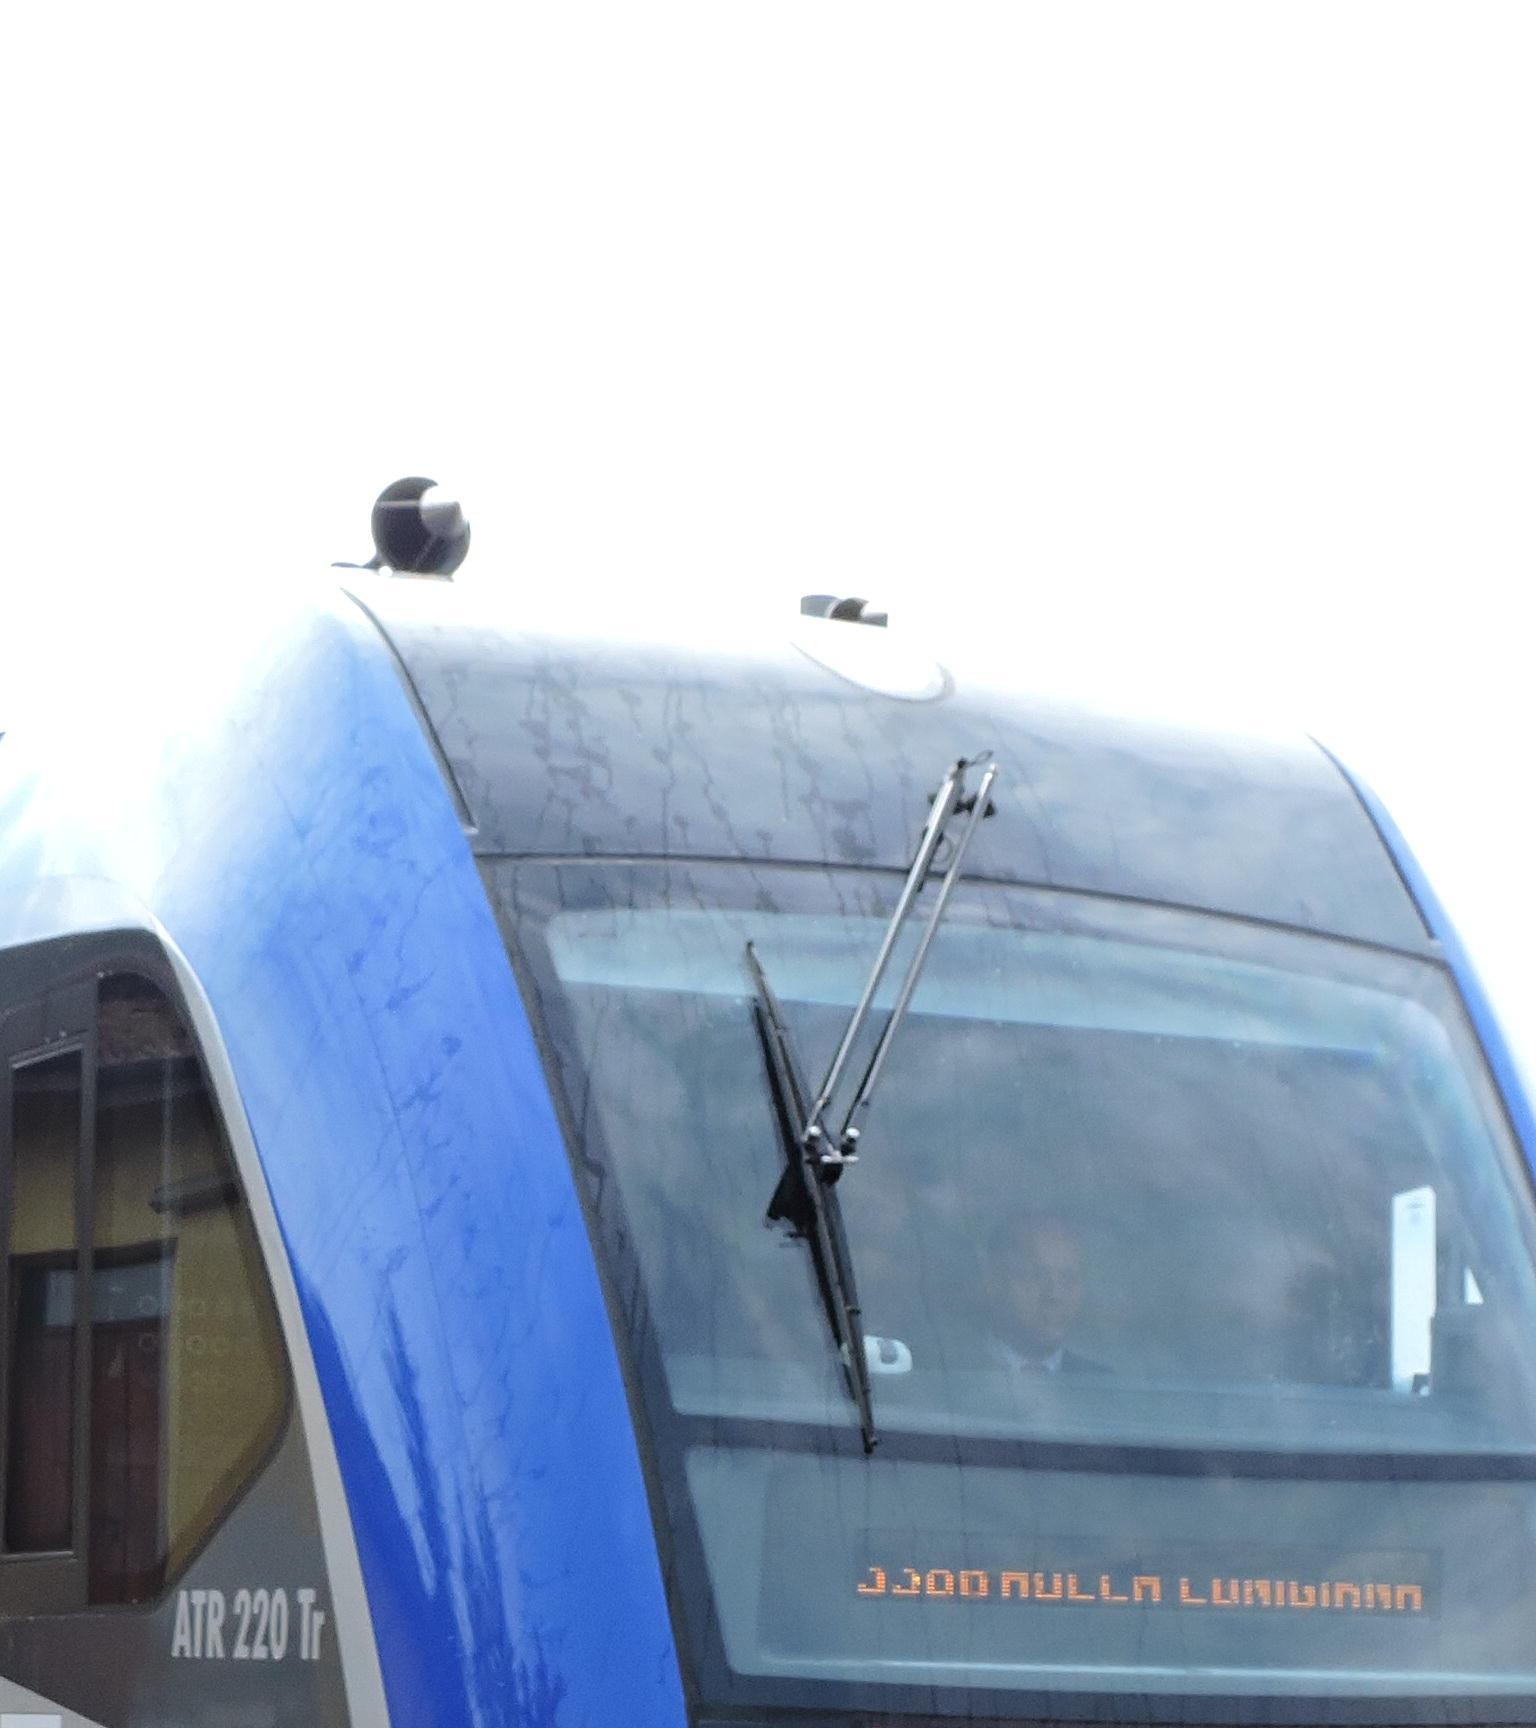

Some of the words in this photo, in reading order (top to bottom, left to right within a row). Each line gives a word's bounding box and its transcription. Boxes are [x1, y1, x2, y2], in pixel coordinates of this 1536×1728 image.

[171, 1589, 226, 1658] ATR
[232, 1587, 290, 1661] 220
[297, 1588, 327, 1661] Tr
